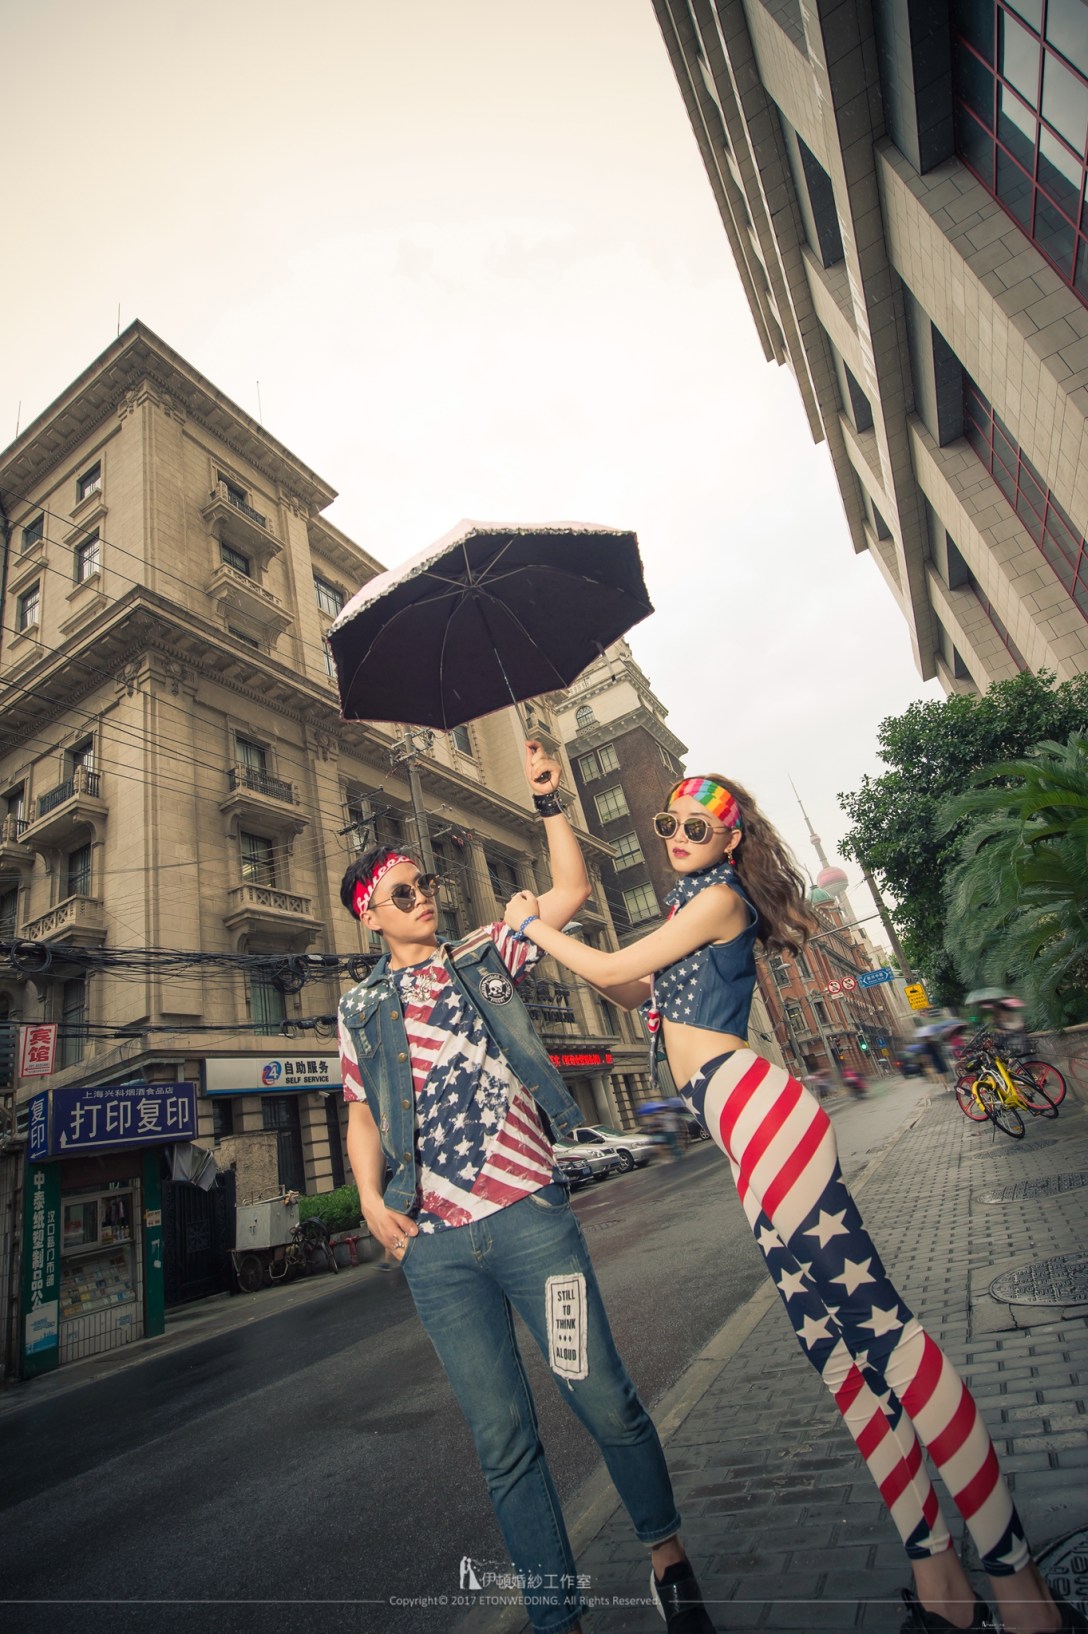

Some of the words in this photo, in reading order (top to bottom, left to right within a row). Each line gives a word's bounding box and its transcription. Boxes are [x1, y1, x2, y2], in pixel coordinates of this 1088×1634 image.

[28, 1028, 52, 1063] 宾馆
[284, 1061, 329, 1075] 自助服务
[303, 1075, 329, 1083] SERVICE
[82, 1087, 174, 1099] 上海兴科烟酒食品店
[30, 1098, 46, 1149] 复印
[70, 1096, 189, 1140] 打印复印
[46, 1210, 56, 1288] 汉口路门市部
[557, 1289, 576, 1302] STILL
[562, 1304, 571, 1316] TO
[556, 1318, 576, 1329] THINK
[556, 1346, 577, 1361] ALOUD
